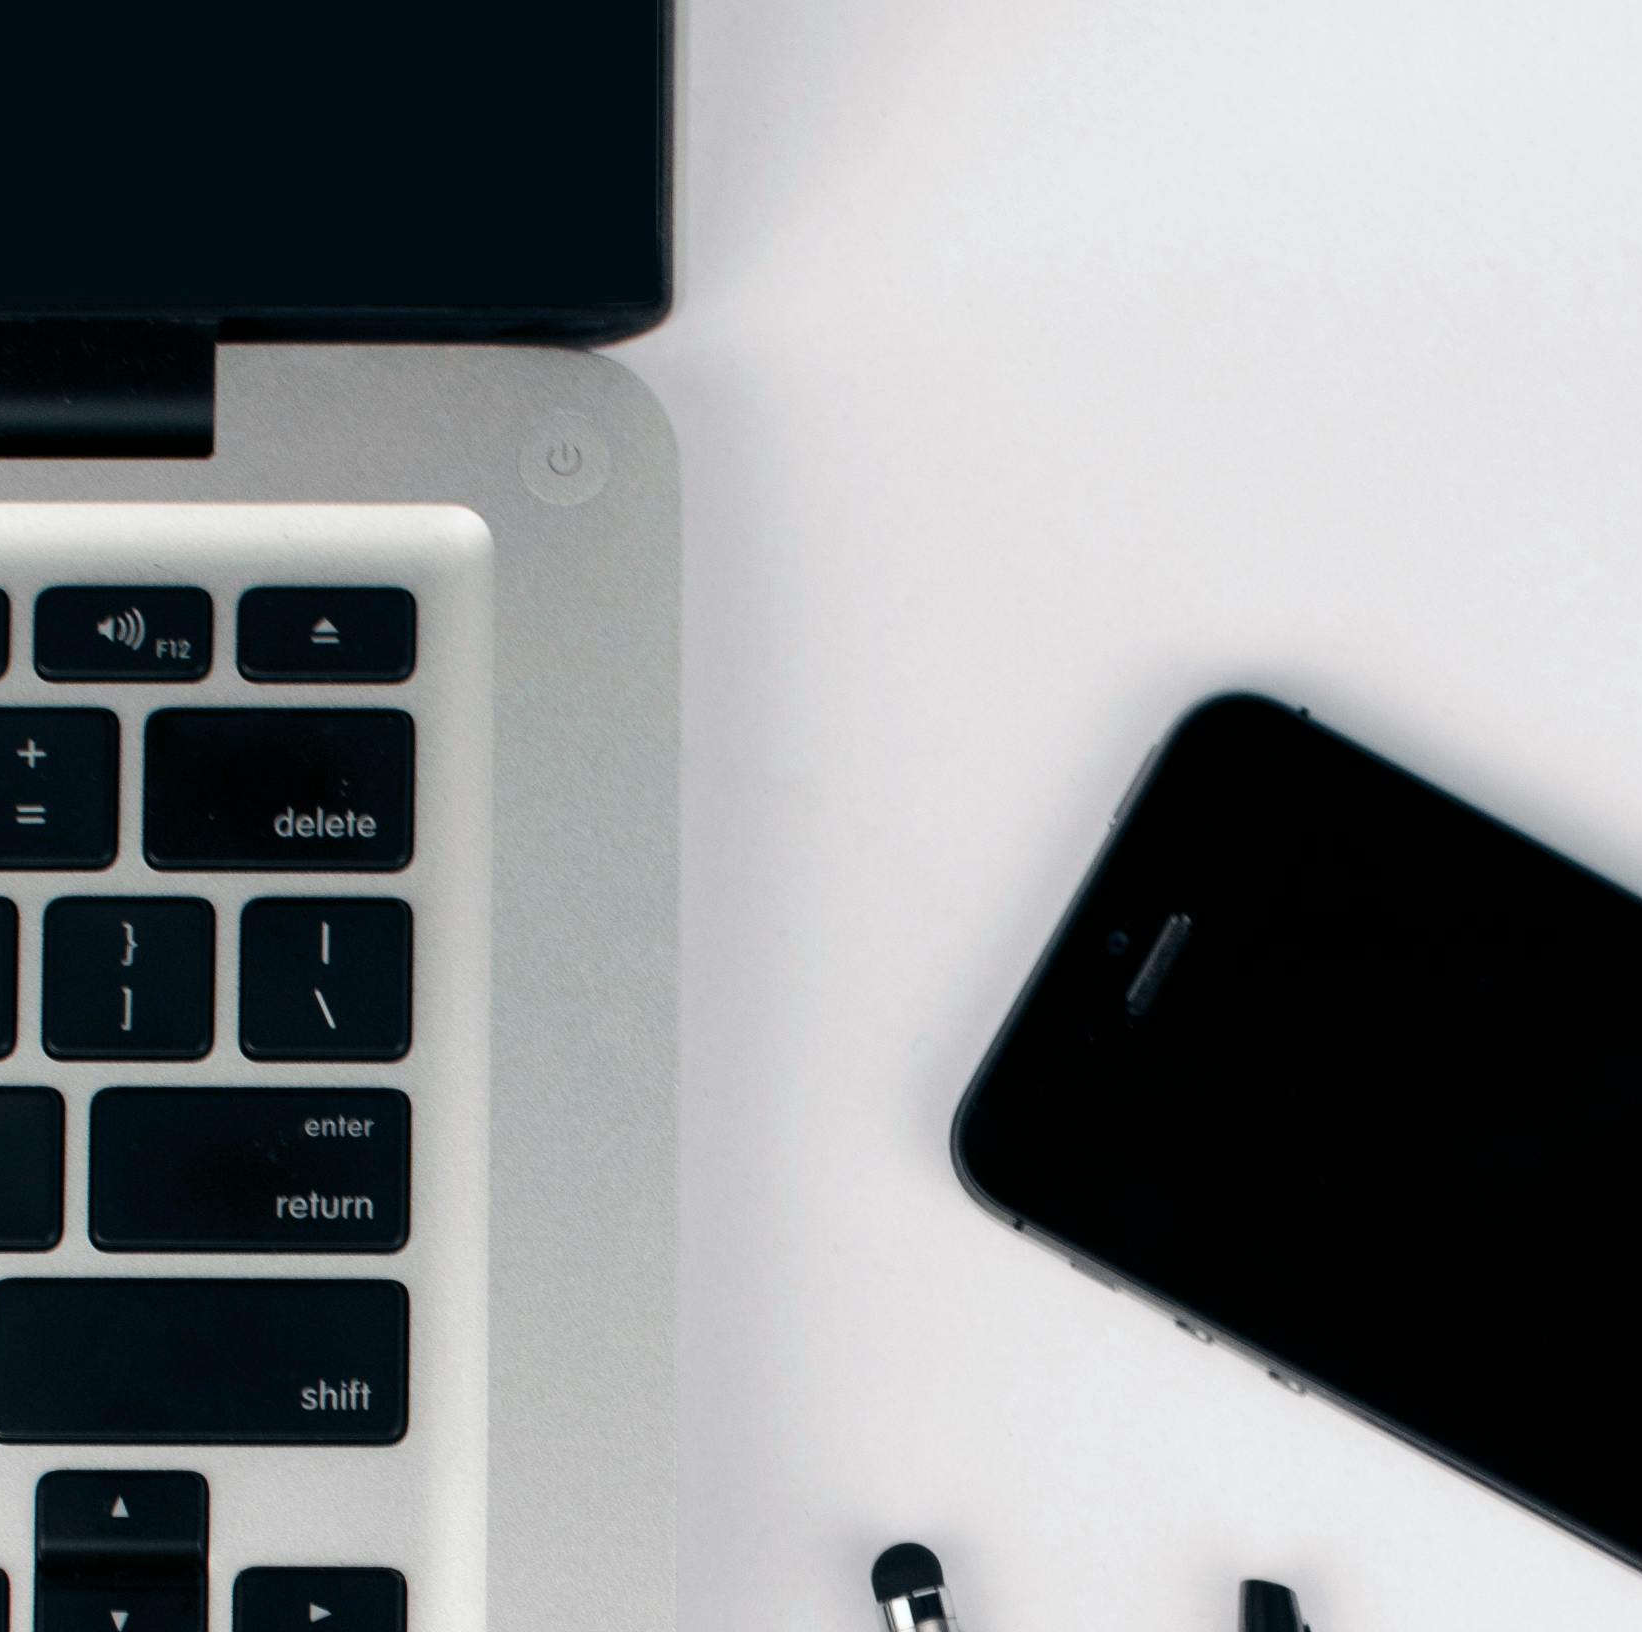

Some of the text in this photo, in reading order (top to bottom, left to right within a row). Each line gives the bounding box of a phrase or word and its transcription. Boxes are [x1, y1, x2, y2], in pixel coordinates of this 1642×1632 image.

[156, 640, 191, 659] F12
[17, 739, 47, 769] +
[16, 805, 46, 825] =
[274, 807, 377, 838] delete
[122, 922, 138, 967] }
[314, 989, 336, 1029] \
[304, 1115, 375, 1138] enter
[276, 1191, 374, 1220] return
[301, 1379, 372, 1411] shift
